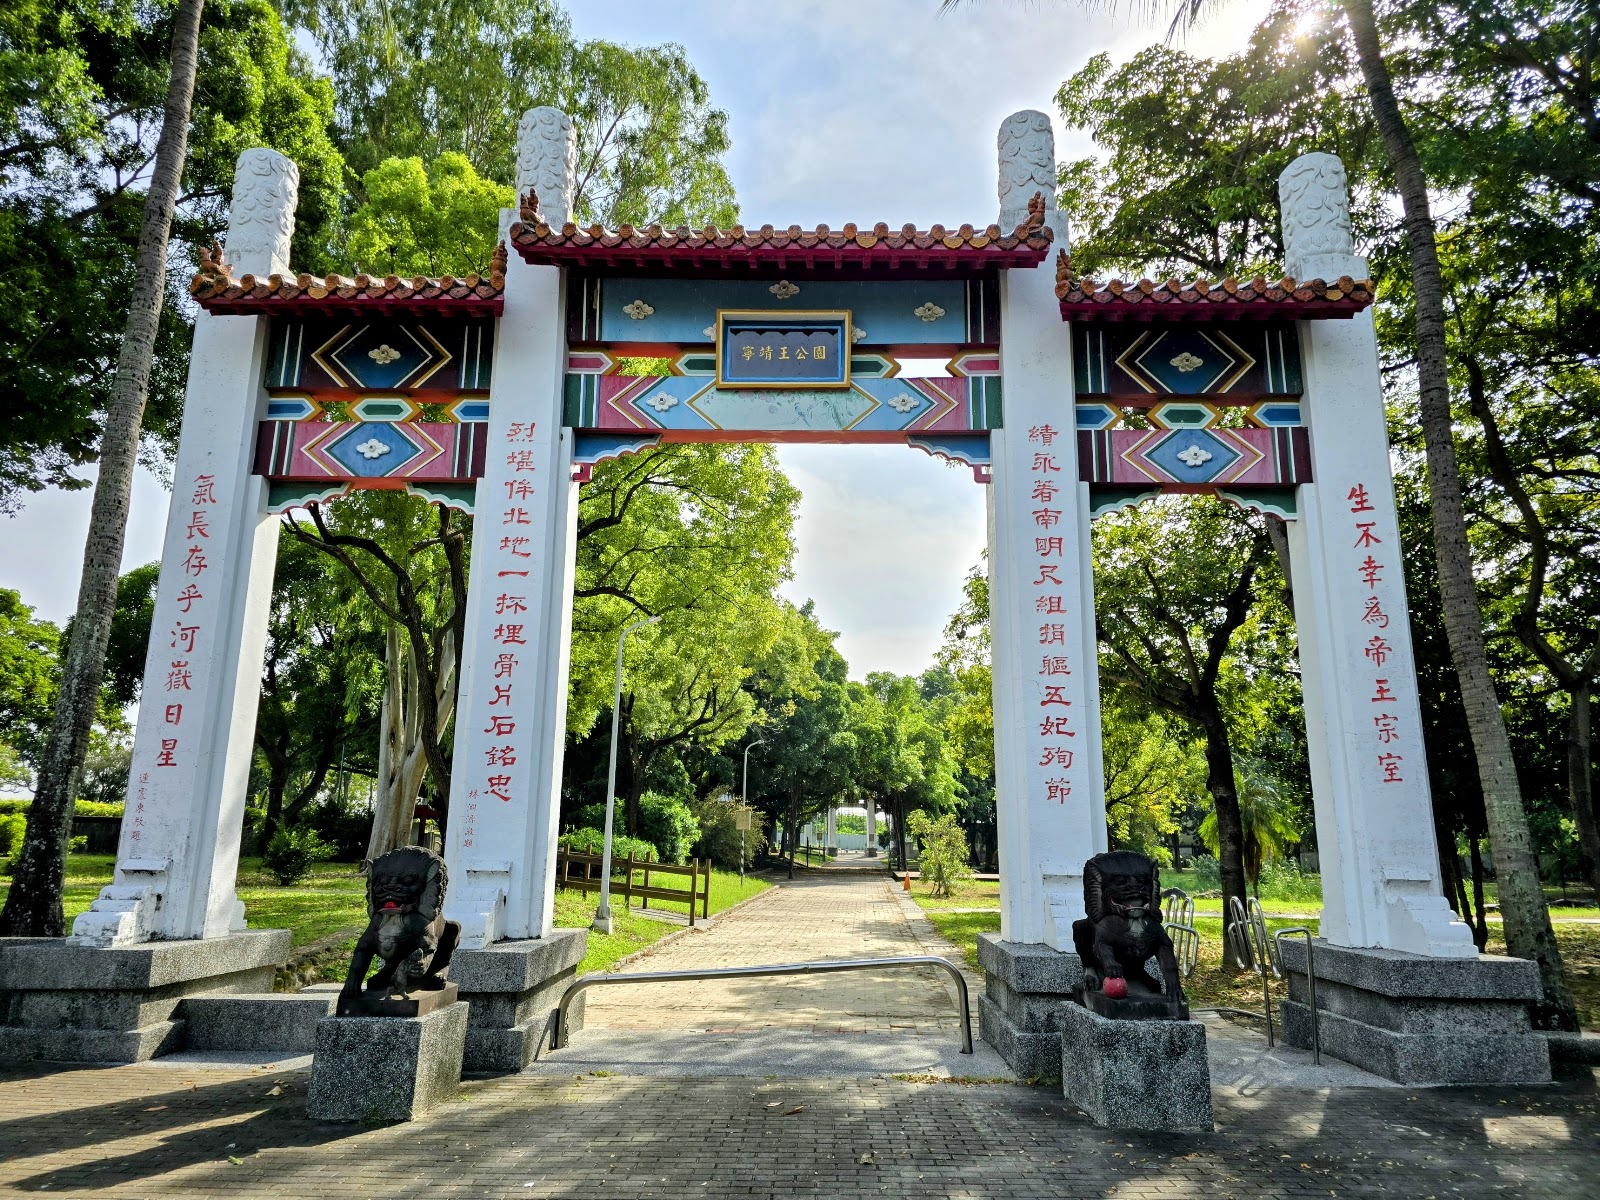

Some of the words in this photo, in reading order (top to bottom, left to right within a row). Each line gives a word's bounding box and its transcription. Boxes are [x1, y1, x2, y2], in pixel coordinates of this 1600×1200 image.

[741, 345, 826, 361] 寧靖王公園
[156, 474, 216, 768] 氣長存乎河嶽日星
